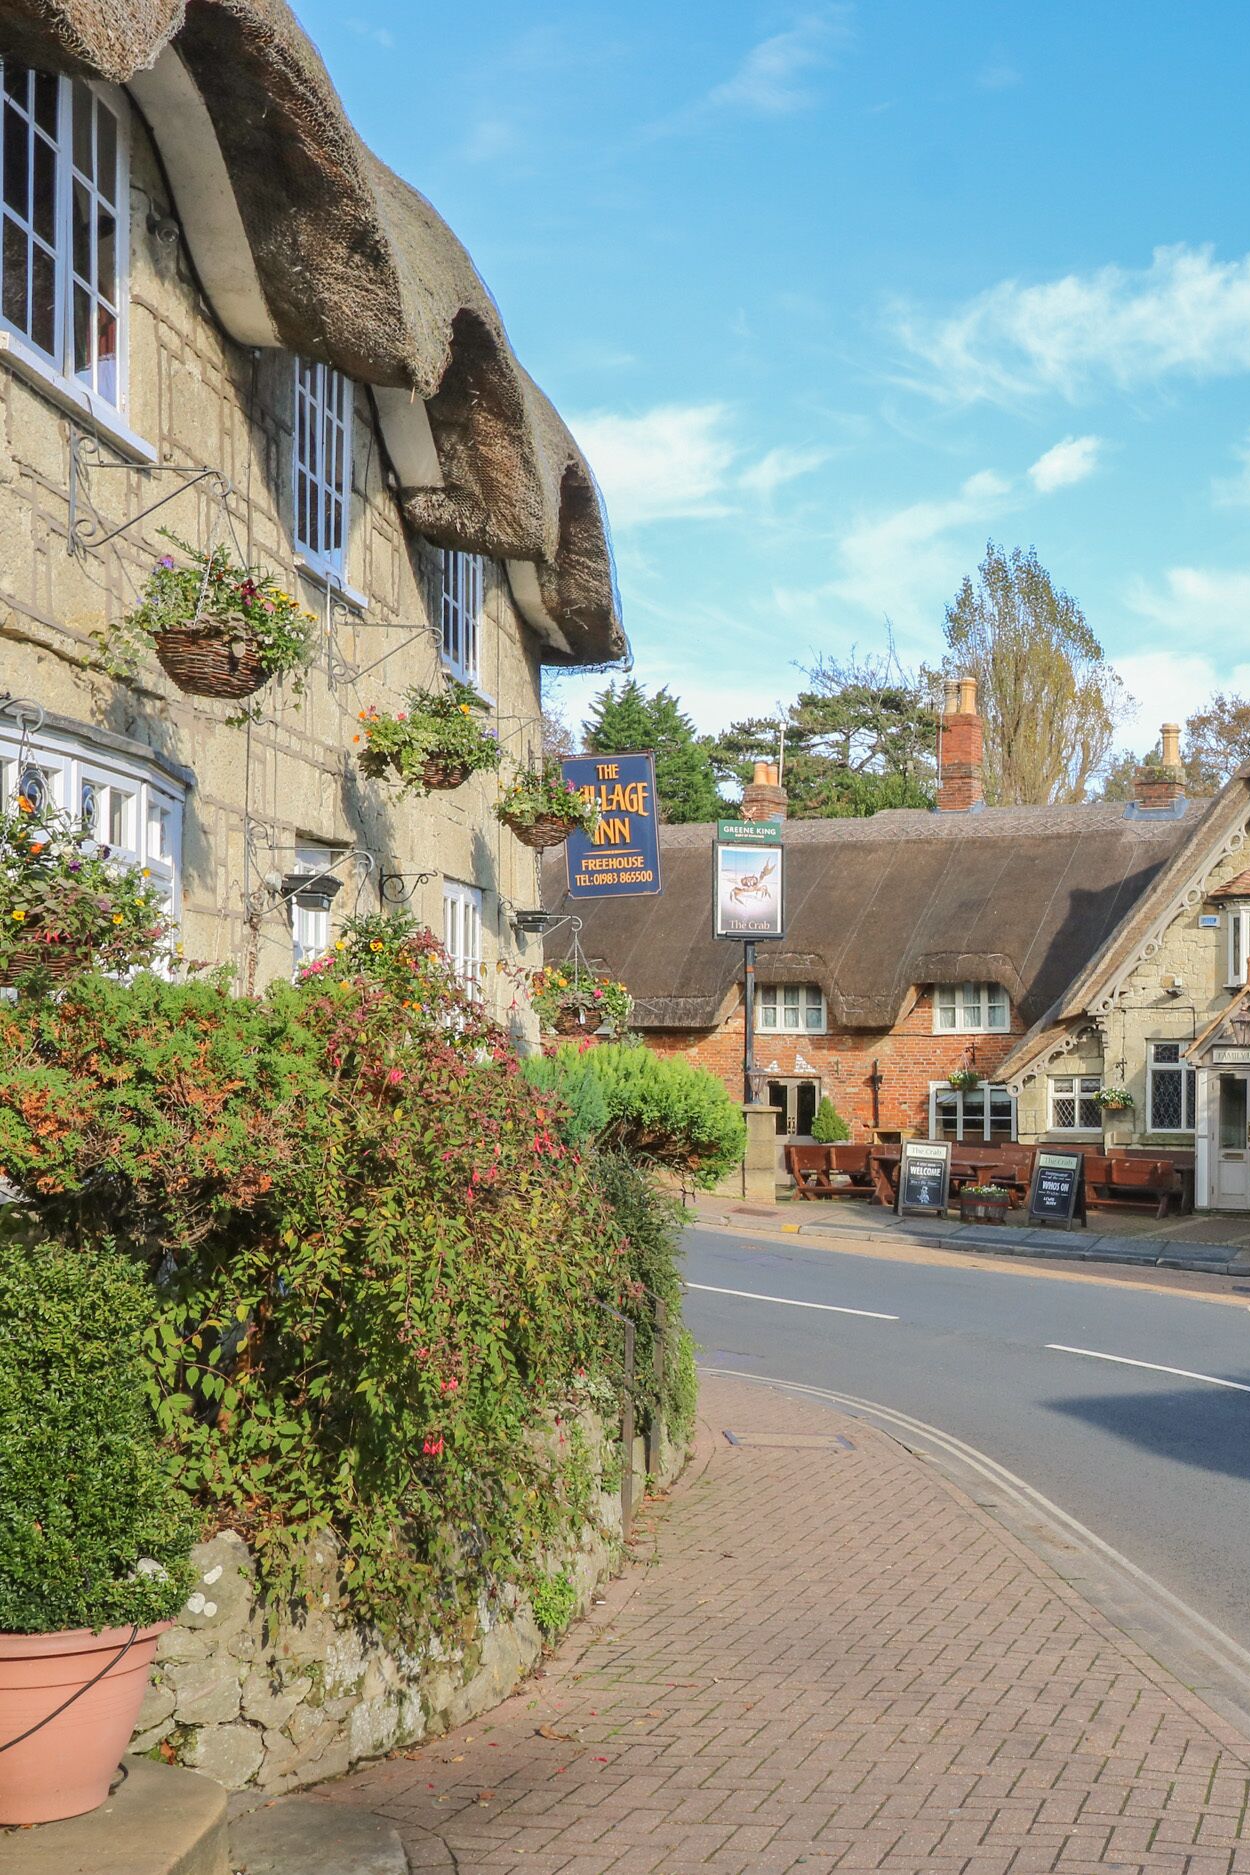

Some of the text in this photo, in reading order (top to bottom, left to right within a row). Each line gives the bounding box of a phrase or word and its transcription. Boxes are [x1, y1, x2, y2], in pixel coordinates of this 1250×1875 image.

[596, 764, 620, 780] THE
[724, 825, 754, 834] GREENE
[756, 827, 776, 836] KING
[582, 856, 644, 871] FREEHOUSE
[620, 871, 653, 884] 865500
[730, 920, 770, 929] The Crab
[910, 1166, 941, 1177] WELCOME
